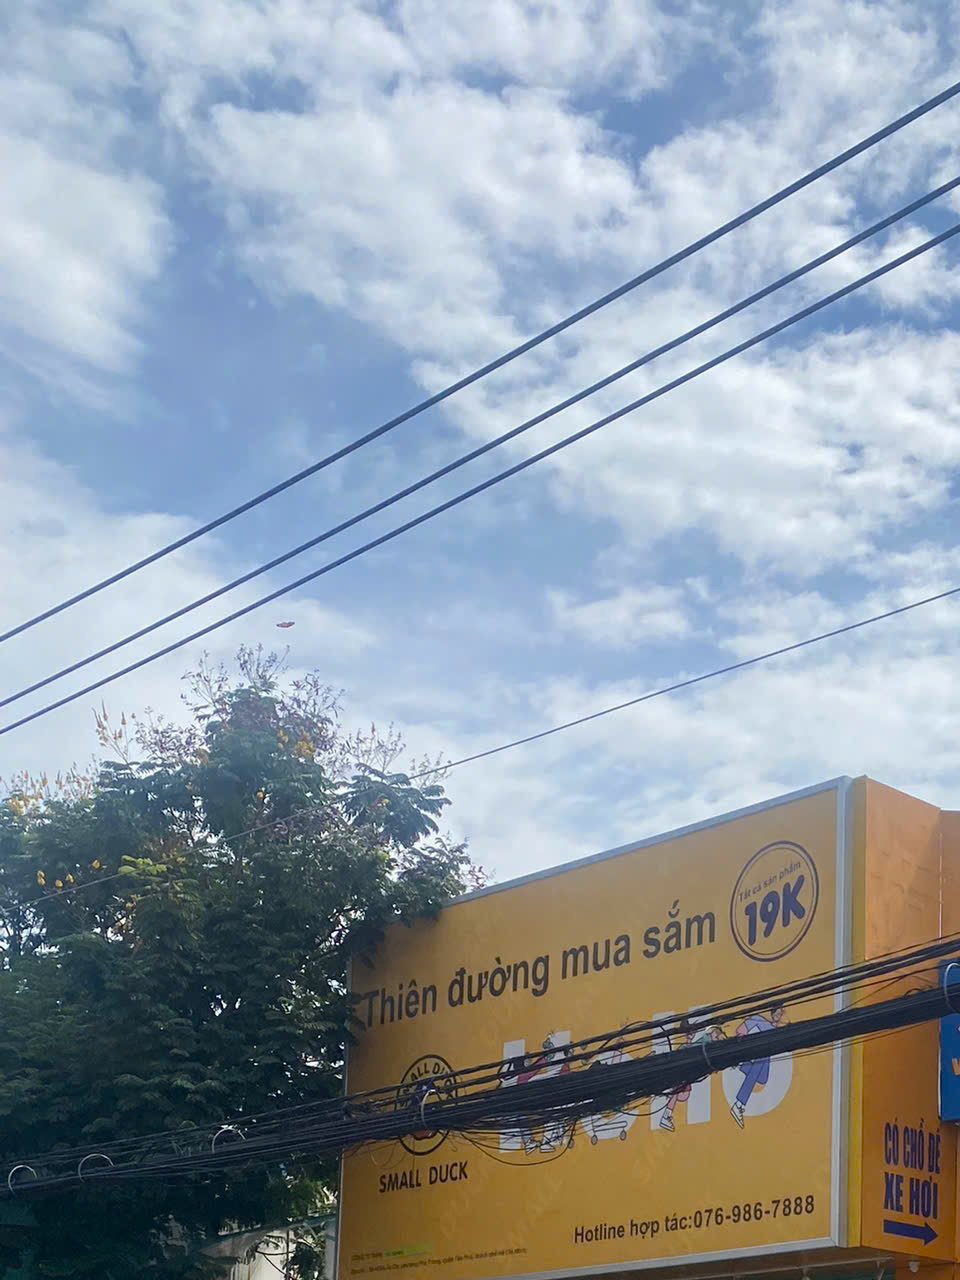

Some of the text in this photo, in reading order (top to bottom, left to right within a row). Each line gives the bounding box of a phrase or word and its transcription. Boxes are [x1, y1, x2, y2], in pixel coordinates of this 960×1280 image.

[745, 874, 806, 947] 19K
[366, 899, 716, 1028] Thiên đường mua sắm
[885, 1116, 899, 1166] CÓ
[378, 1160, 468, 1194] SMALL DUCK
[884, 1171, 938, 1220] XE HƠI
[574, 1194, 815, 1244] Hotline hợp tác:076-986-7888
